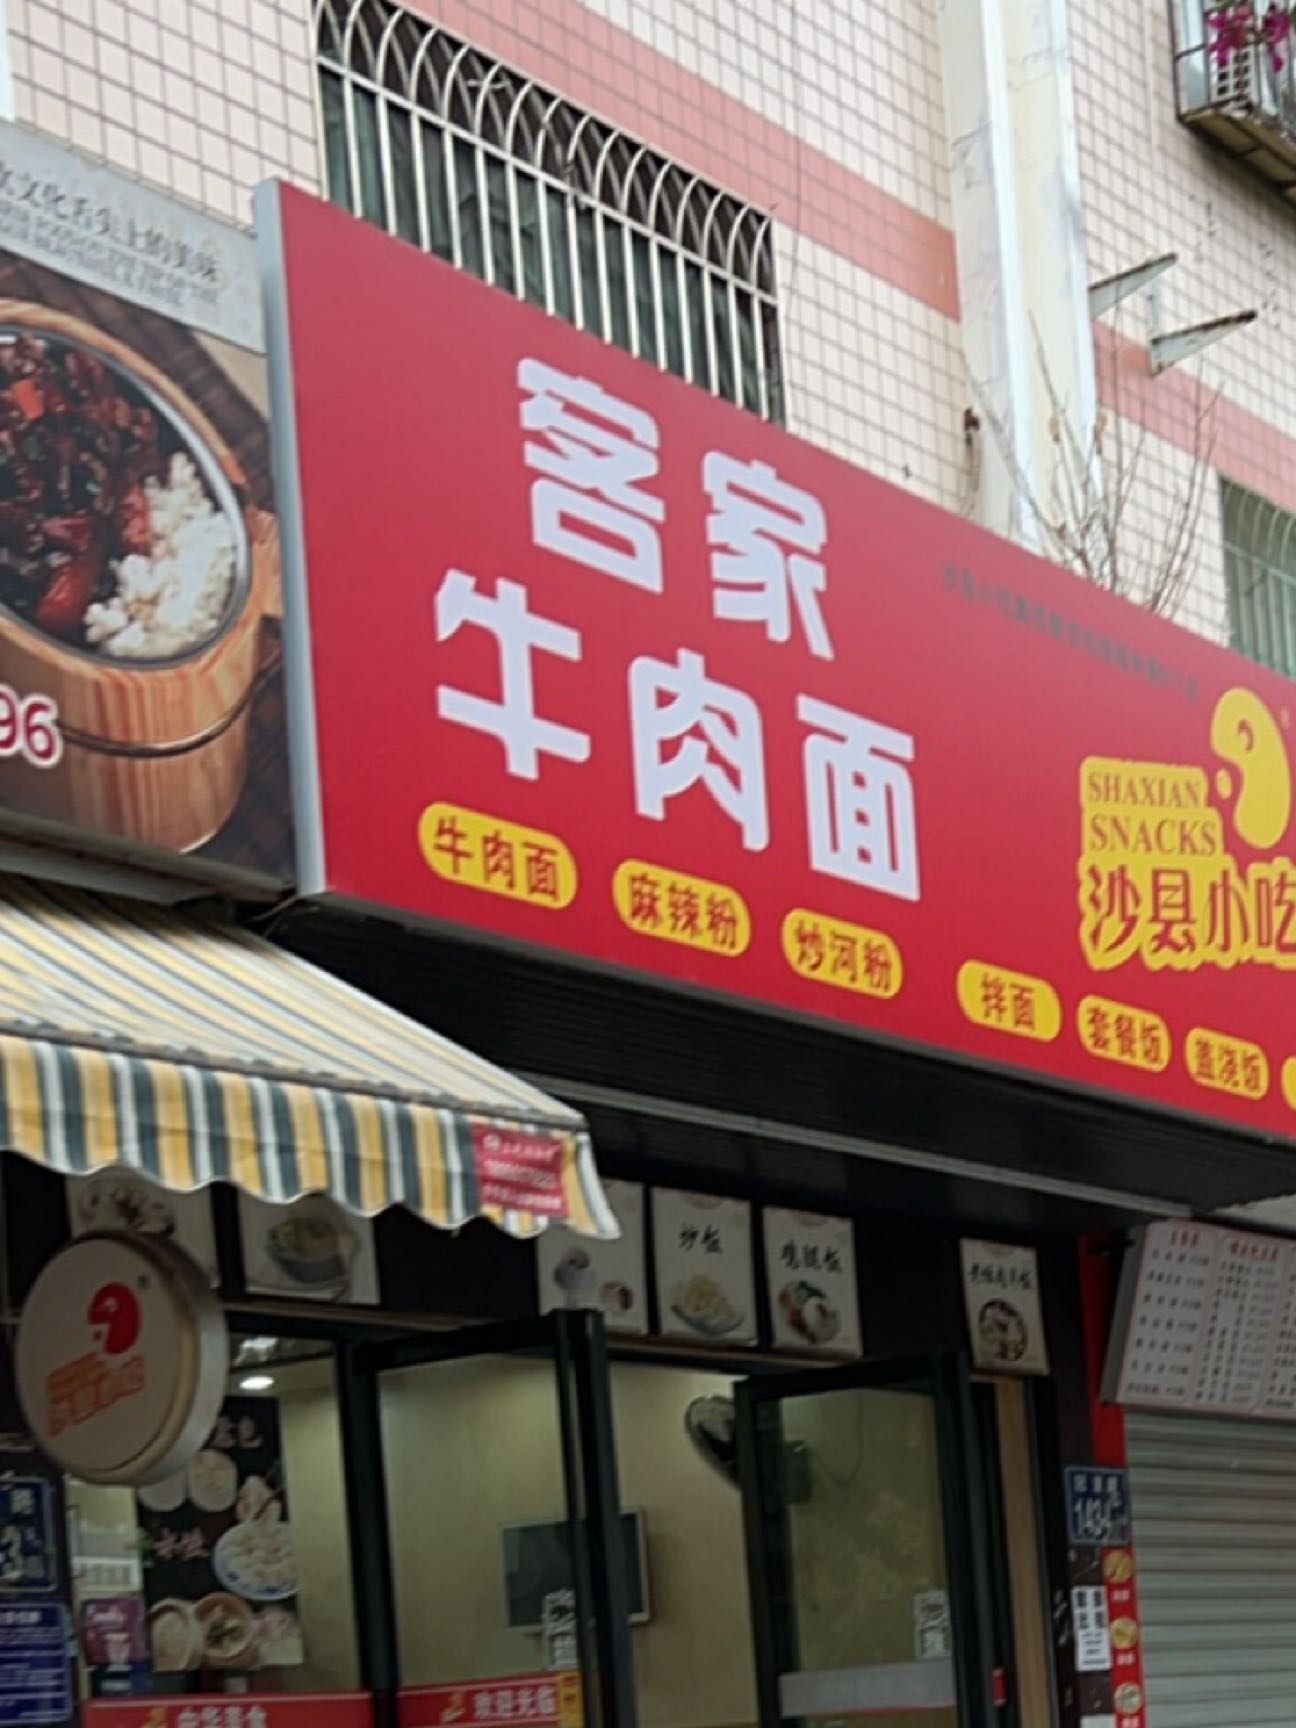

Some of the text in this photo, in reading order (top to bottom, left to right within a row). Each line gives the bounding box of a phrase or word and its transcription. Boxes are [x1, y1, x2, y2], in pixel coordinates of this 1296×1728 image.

[517, 357, 834, 660] 客家
[433, 567, 921, 902] 牛肉面
[1087, 771, 1201, 808] SHAXIAN
[432, 816, 562, 902] 牛肉面
[1090, 814, 1218, 855] SNACKS
[629, 873, 736, 950] 麻辣粉
[794, 925, 891, 991] 炒河粉
[1087, 1005, 1163, 1065] 套餐饭
